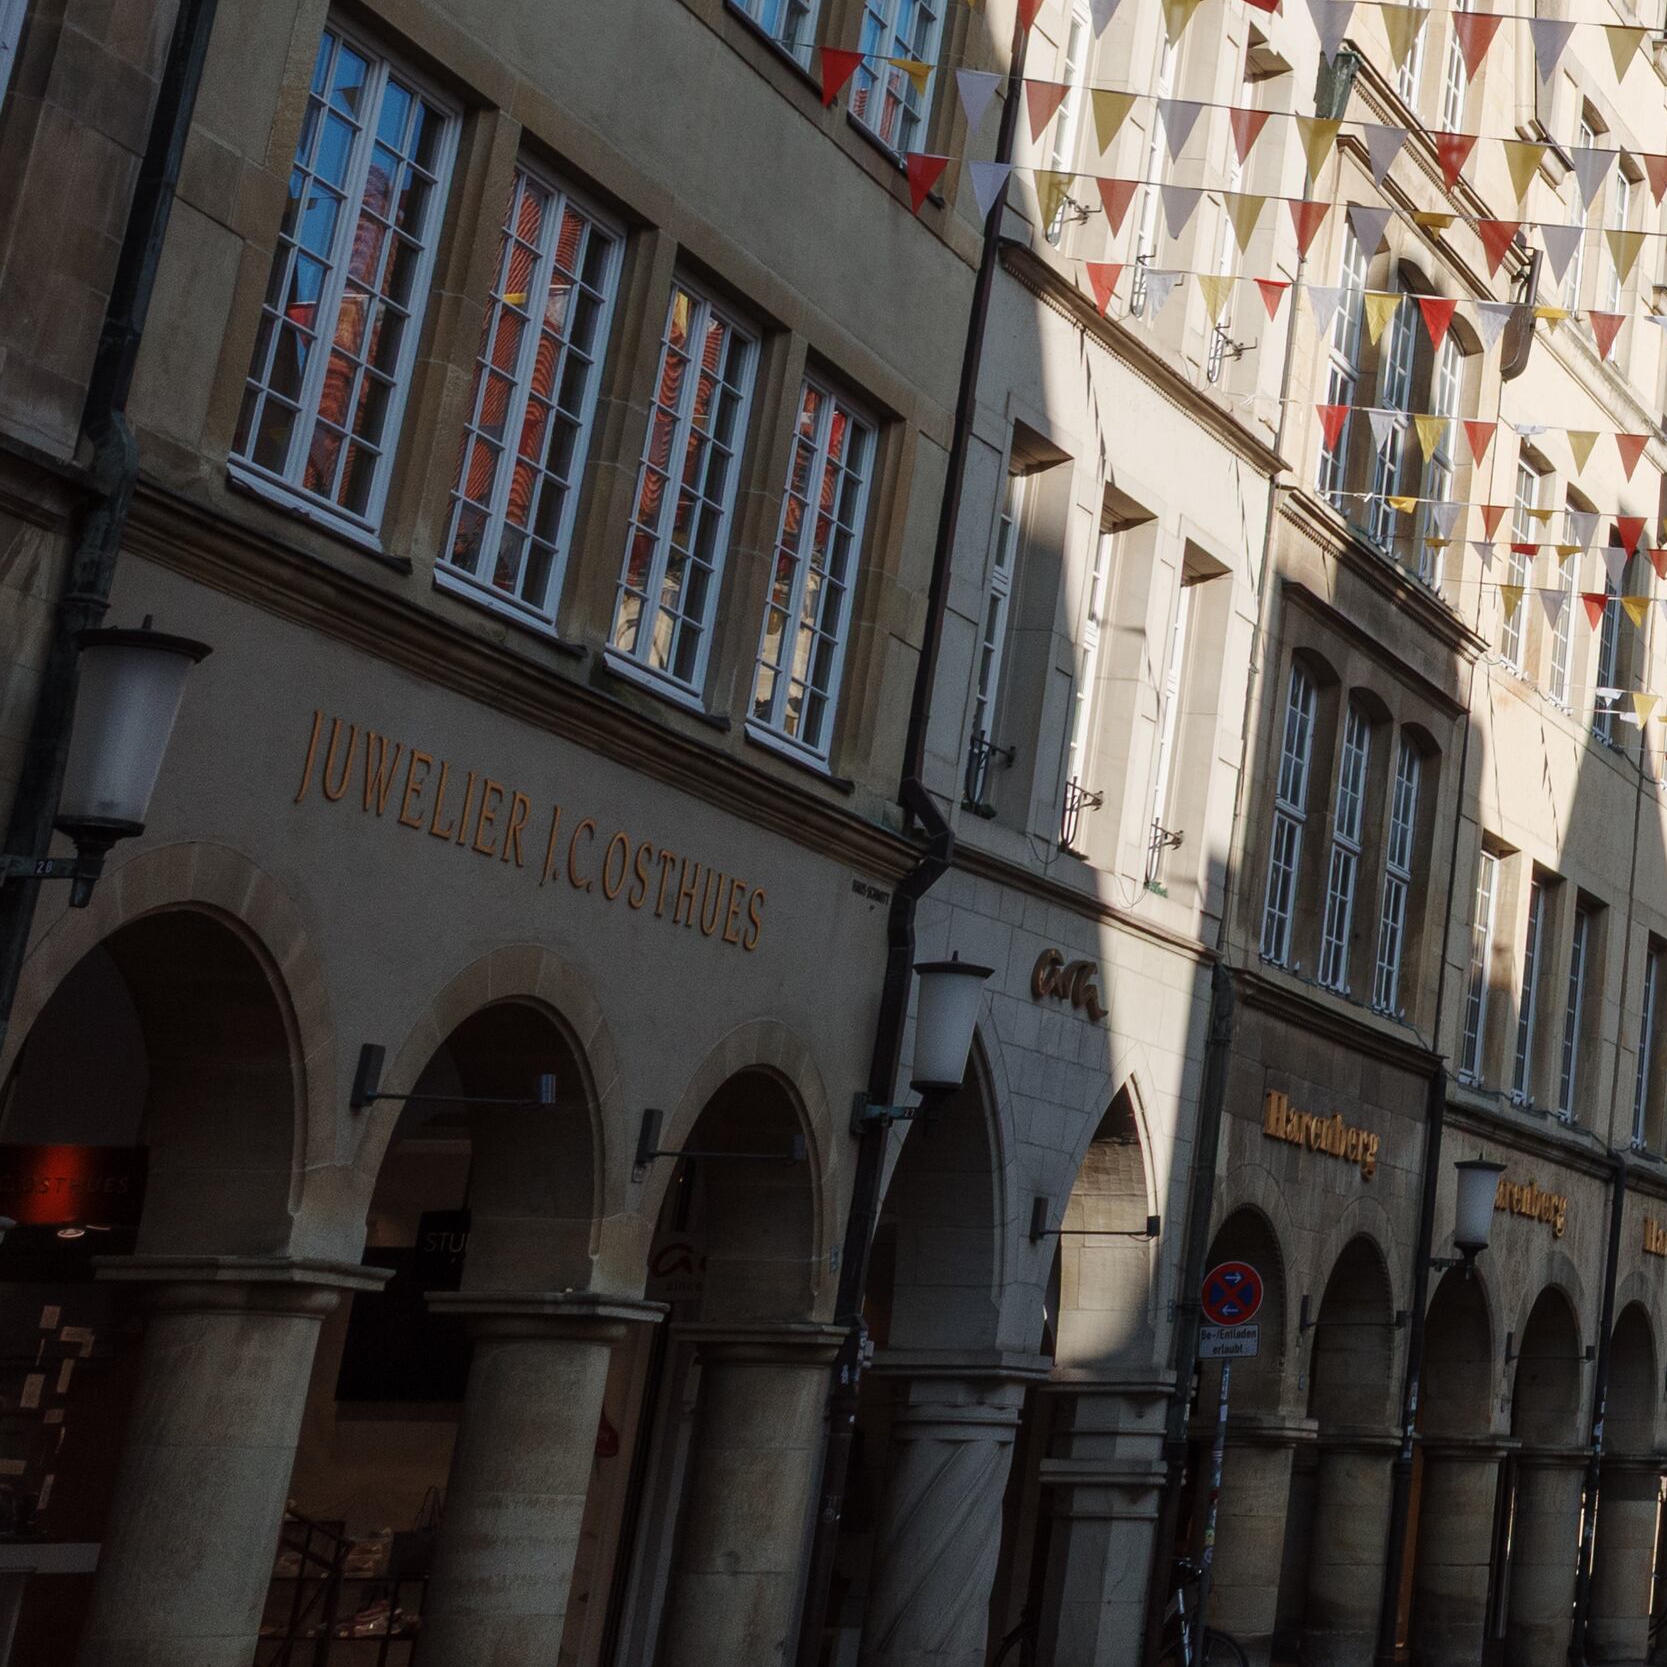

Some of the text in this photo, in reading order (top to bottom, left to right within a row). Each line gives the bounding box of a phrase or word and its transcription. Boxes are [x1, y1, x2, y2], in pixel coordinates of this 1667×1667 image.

[294, 709, 532, 868] JUWELIER
[602, 831, 766, 951] OSTHUES
[1263, 1089, 1380, 1183] Harenberg
[1495, 1178, 1568, 1239] arenberg
[1201, 1328, 1257, 1340] Be-/Entladen
[1212, 1344, 1243, 1354] erlaubt
